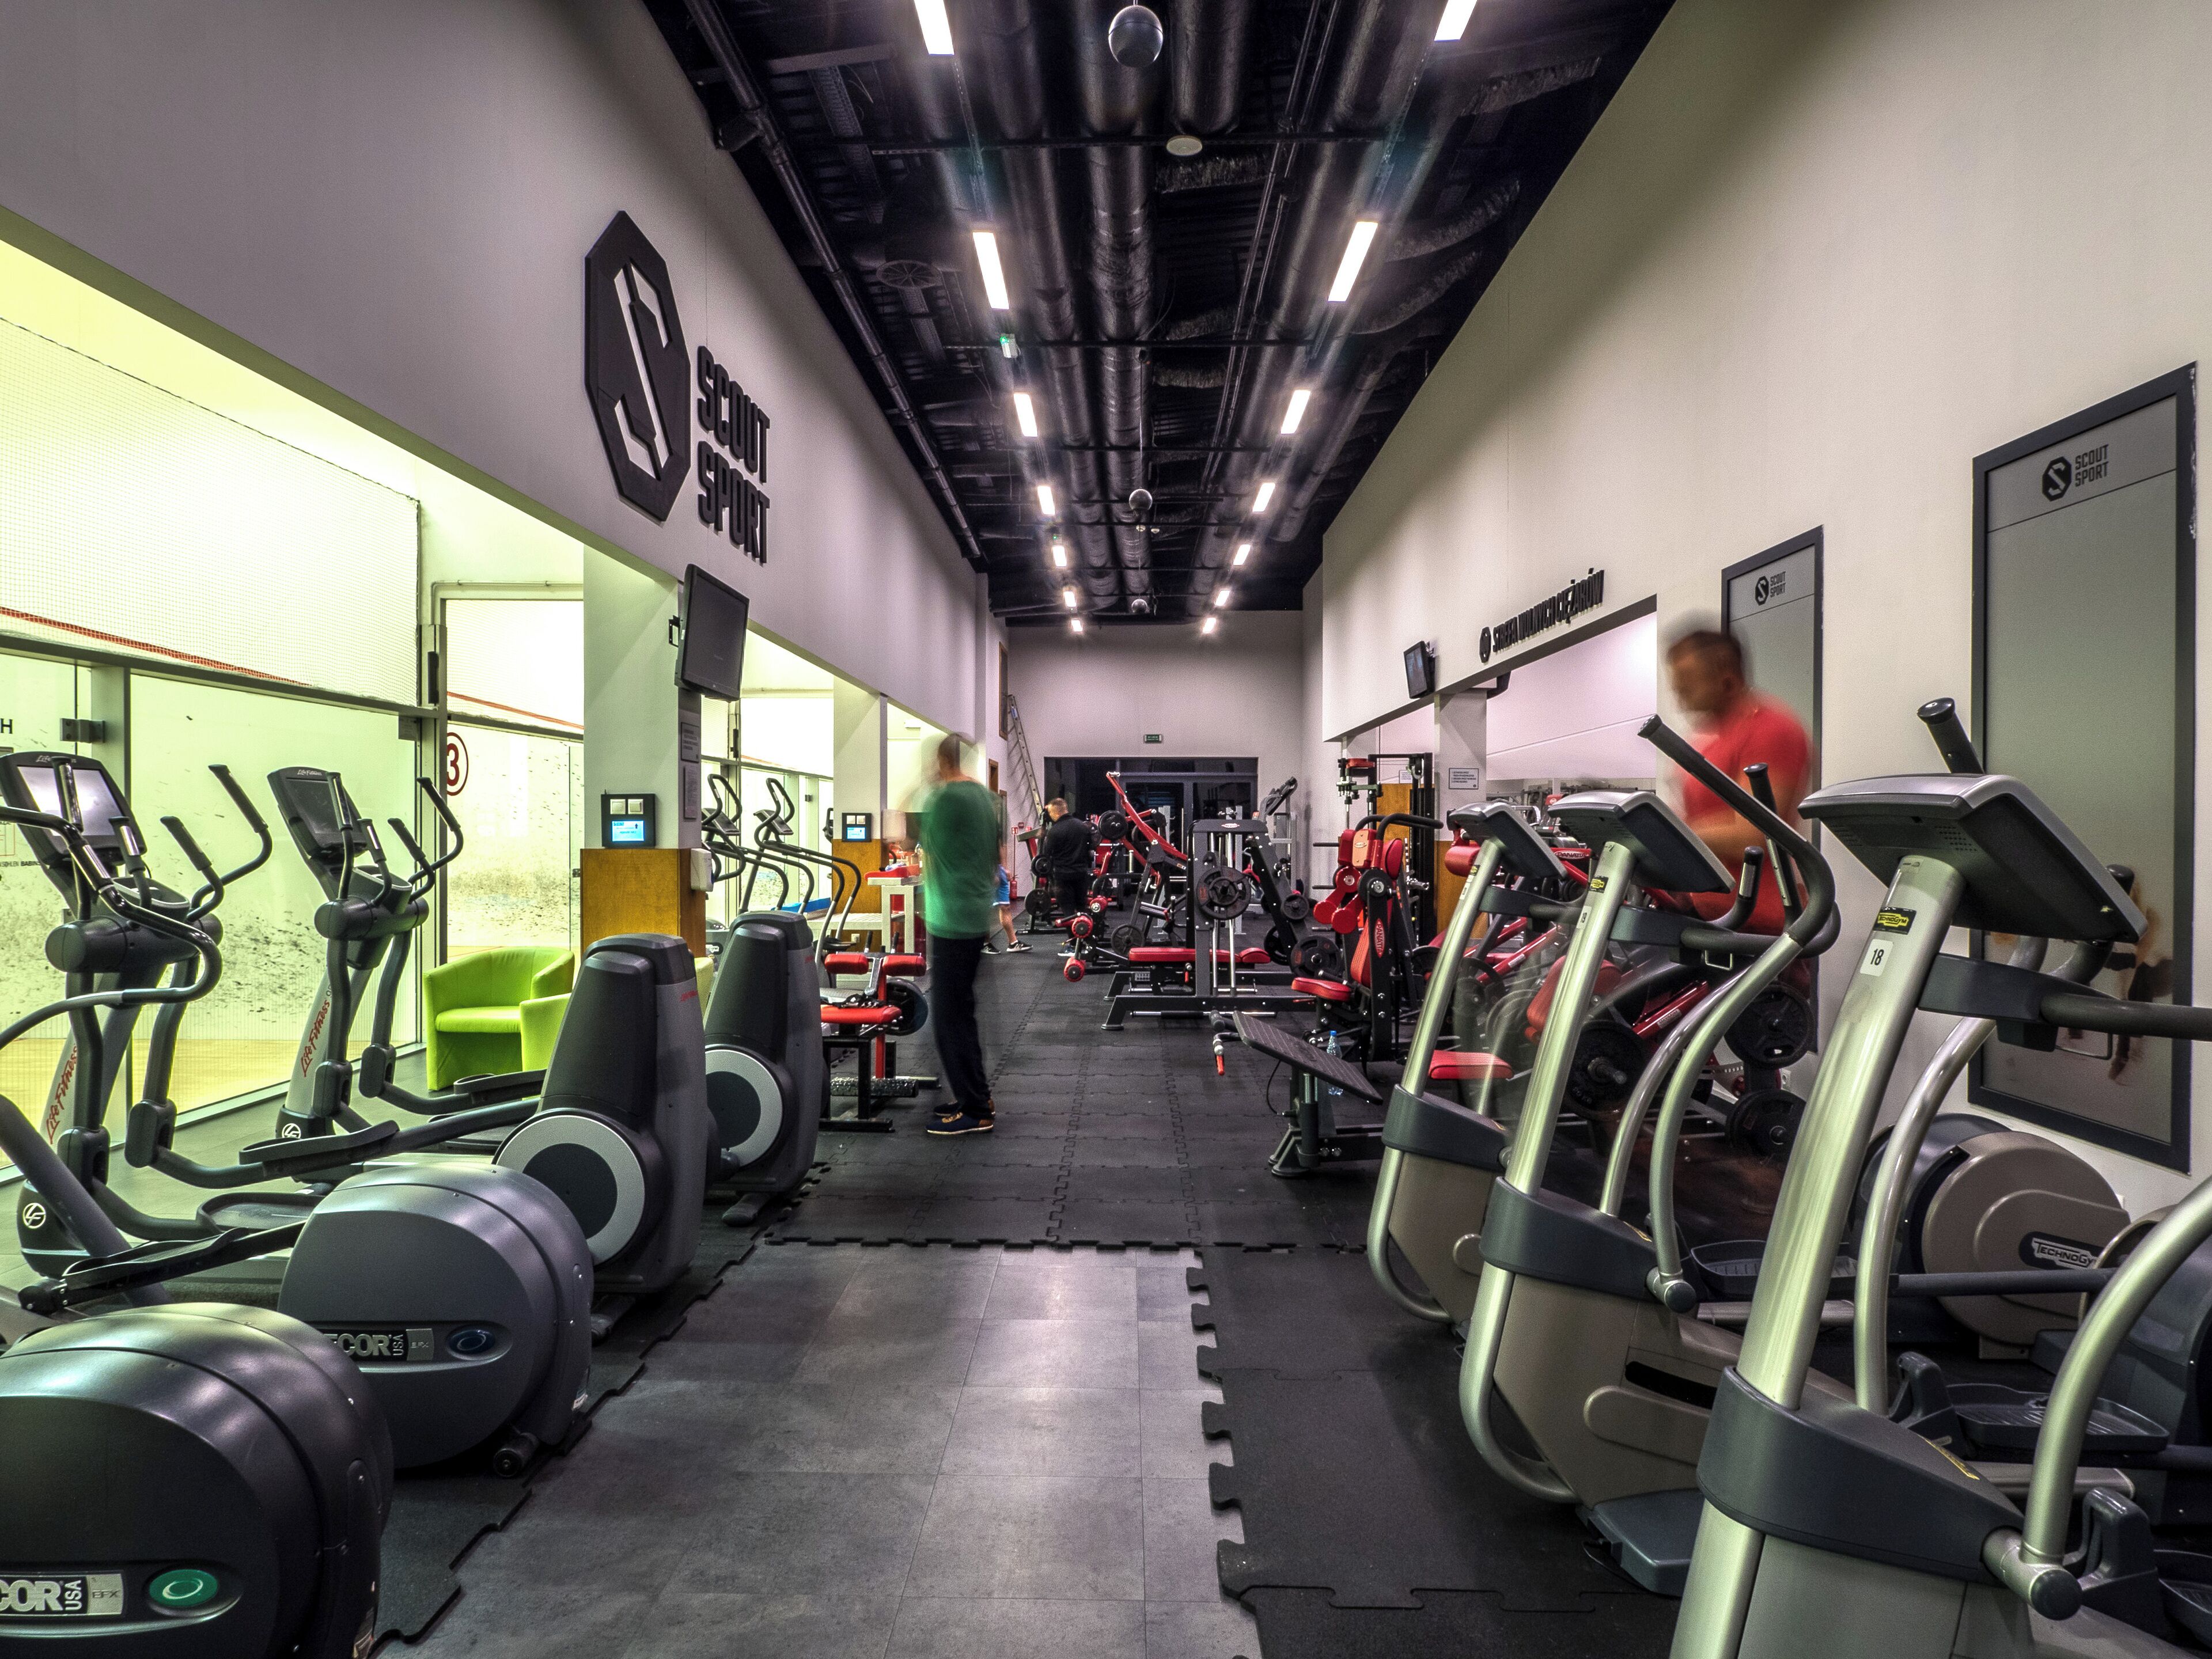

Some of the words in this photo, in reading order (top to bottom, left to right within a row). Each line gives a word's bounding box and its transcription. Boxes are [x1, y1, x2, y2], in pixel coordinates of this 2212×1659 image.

[697, 346, 770, 483] SCOUT
[2075, 444, 2108, 470] SCOUT
[2075, 461, 2108, 487] SPORT
[697, 441, 770, 564] SPORT
[1770, 571, 1786, 586] SCOUT
[1770, 582, 1786, 598] SPORT
[447, 743, 460, 786] 3
[1870, 948, 1884, 965] 18
[301, 1046, 313, 1077] Life
[46, 1105, 60, 1145] Life
[2033, 1240, 2094, 1267] TECHNOGY
[393, 1334, 403, 1355] USA
[65, 1580, 82, 1611] USA
[92, 1589, 120, 1599] EFX
